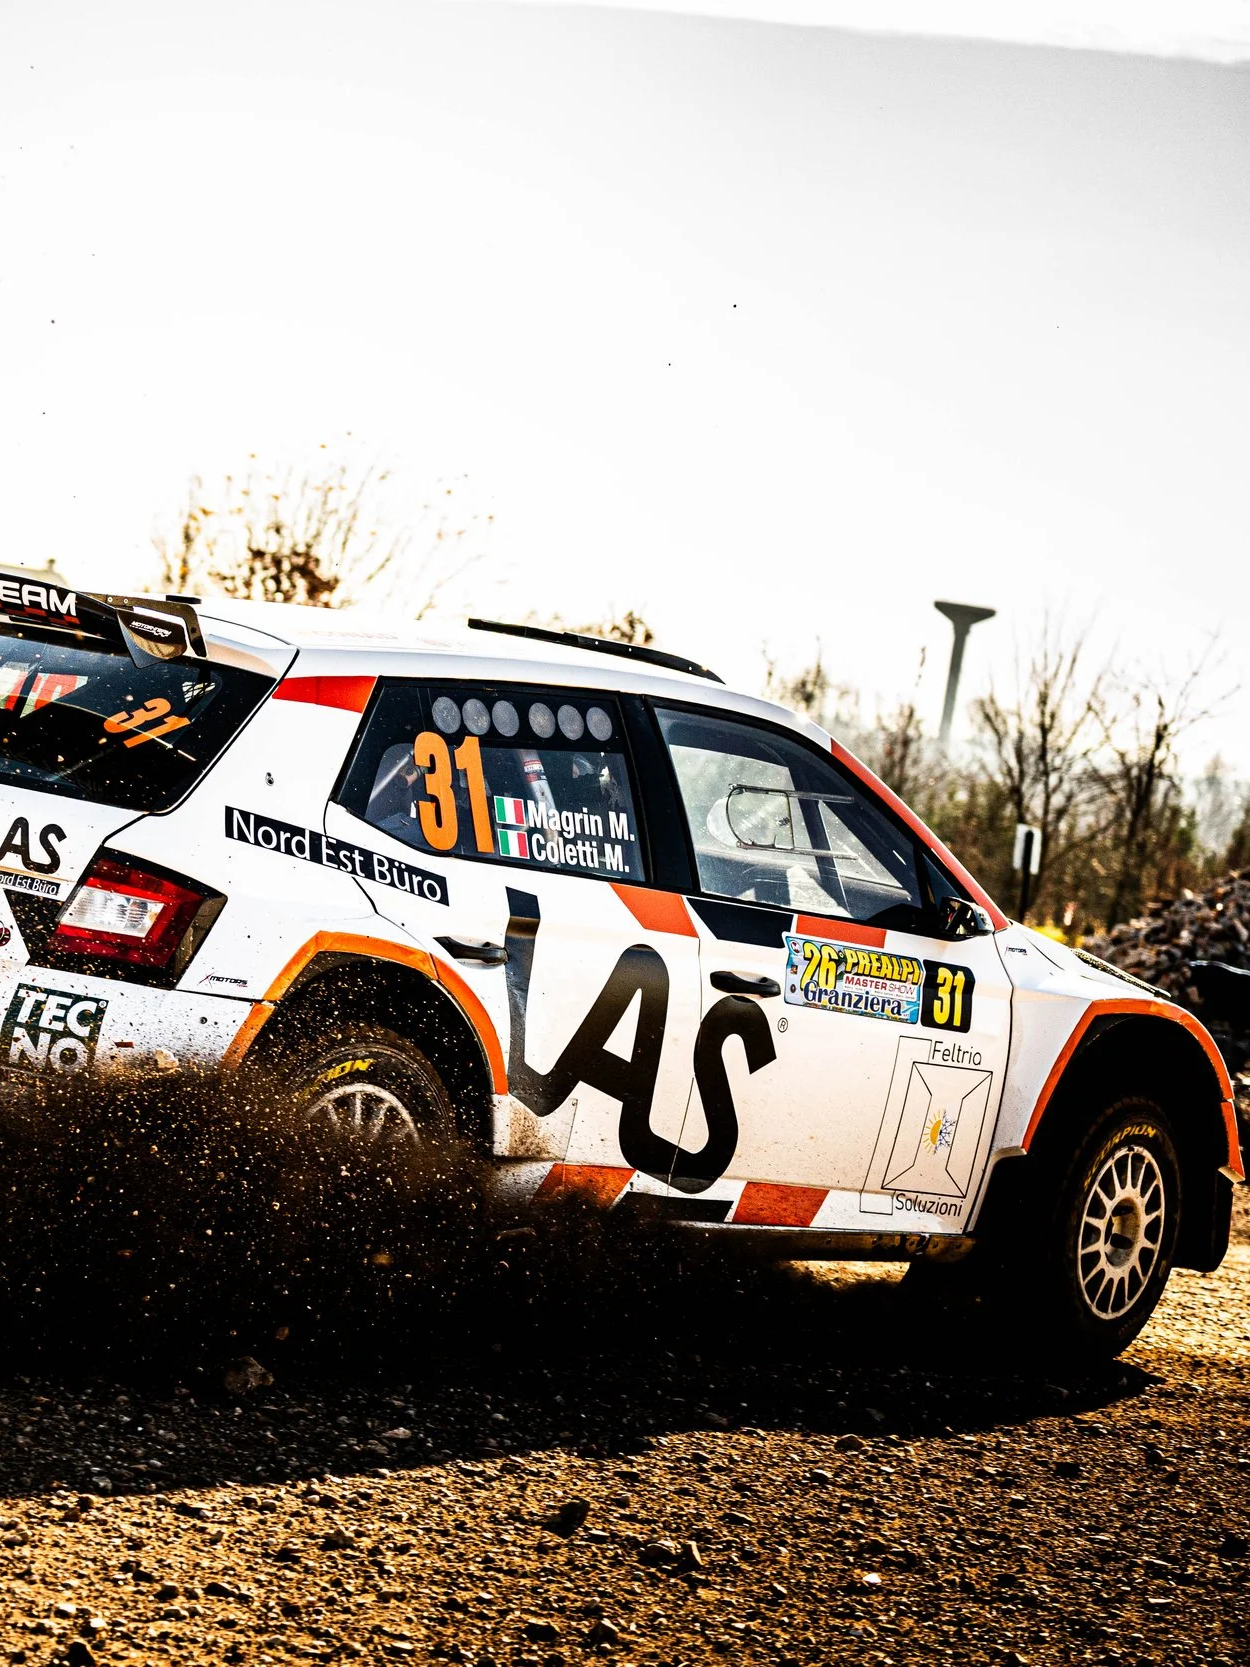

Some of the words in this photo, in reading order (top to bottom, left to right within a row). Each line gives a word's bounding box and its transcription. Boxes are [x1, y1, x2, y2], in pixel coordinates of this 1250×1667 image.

[103, 698, 190, 748] 31
[414, 731, 494, 854] 31
[527, 799, 602, 838] Magrin
[608, 811, 635, 841] M.
[233, 809, 311, 861] Nord
[321, 836, 366, 877] Est
[373, 853, 442, 902] Büro
[531, 833, 599, 869] Coletti
[605, 845, 629, 872] M.
[15, 875, 32, 890] Est
[32, 879, 57, 895] Büro
[843, 948, 923, 986] PREALPI
[844, 975, 888, 991] MASTER
[888, 982, 916, 996] SHOW
[17, 987, 99, 1038] TEC
[803, 980, 903, 1017] Granziera
[933, 967, 966, 1027] 31
[8, 1026, 89, 1072] NO
[505, 886, 777, 1194] LAS
[895, 1192, 965, 1218] Soluzioni
